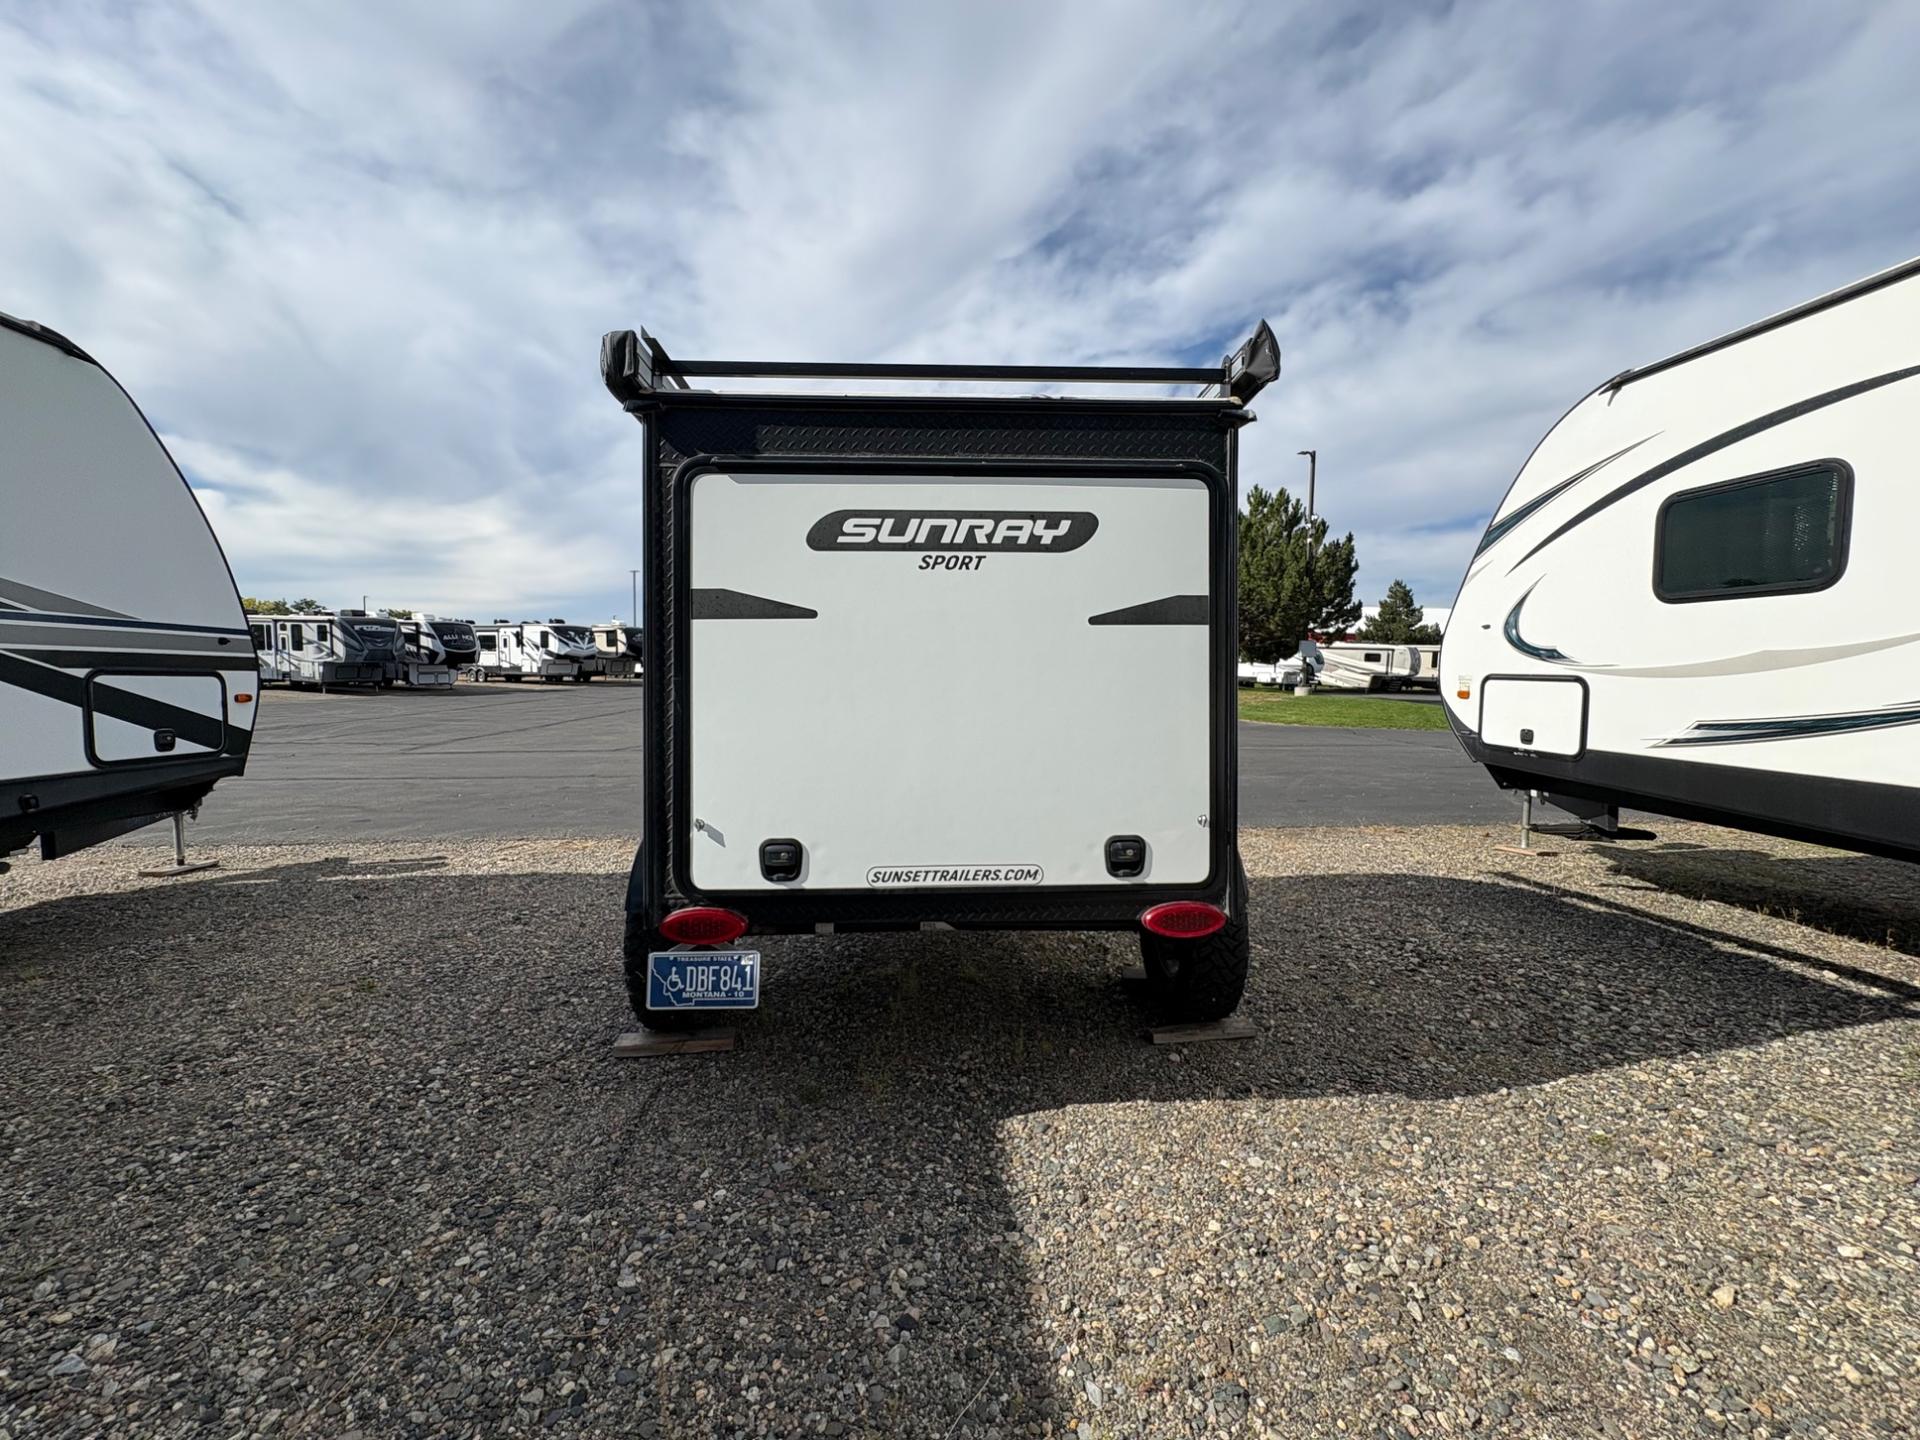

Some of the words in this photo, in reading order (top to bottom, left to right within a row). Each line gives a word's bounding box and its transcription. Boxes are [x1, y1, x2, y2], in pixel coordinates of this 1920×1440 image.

[837, 517, 1072, 544] SUNRAY
[918, 554, 987, 571] SPORT
[443, 633, 474, 641] ALLINCE
[871, 868, 1039, 884] SUNSETTRAILERS.COM
[685, 965, 754, 991] DBF841
[734, 990, 744, 998] 10
